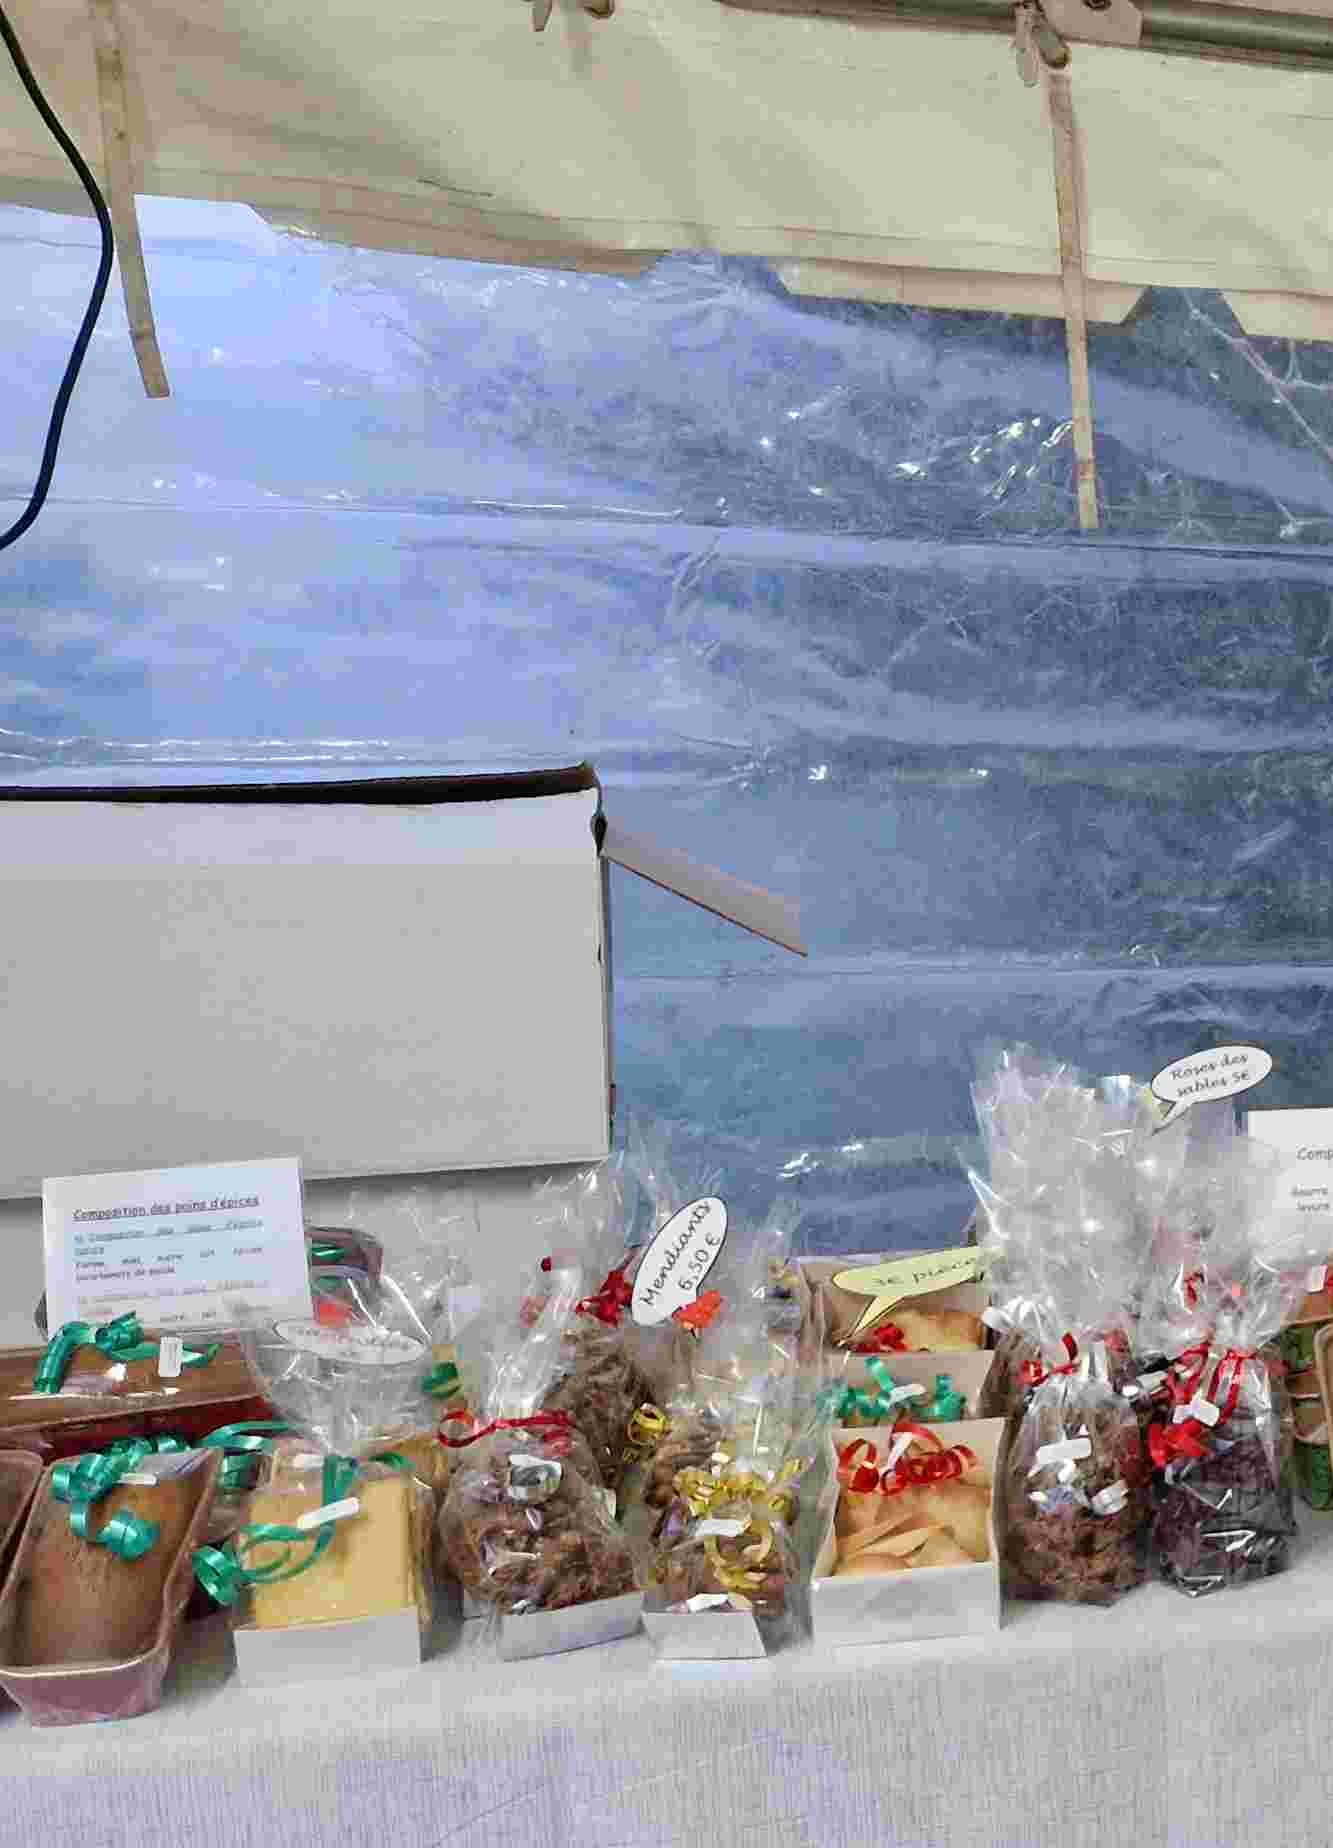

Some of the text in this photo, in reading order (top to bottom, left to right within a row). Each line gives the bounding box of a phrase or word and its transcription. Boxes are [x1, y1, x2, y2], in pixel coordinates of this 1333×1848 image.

[1170, 1053, 1249, 1081] Roses des
[1177, 1077, 1227, 1097] sables
[73, 1205, 146, 1222] Composition
[150, 1200, 171, 1216] des
[639, 1199, 712, 1306] Mendiants
[678, 1231, 721, 1291] 6,50 €
